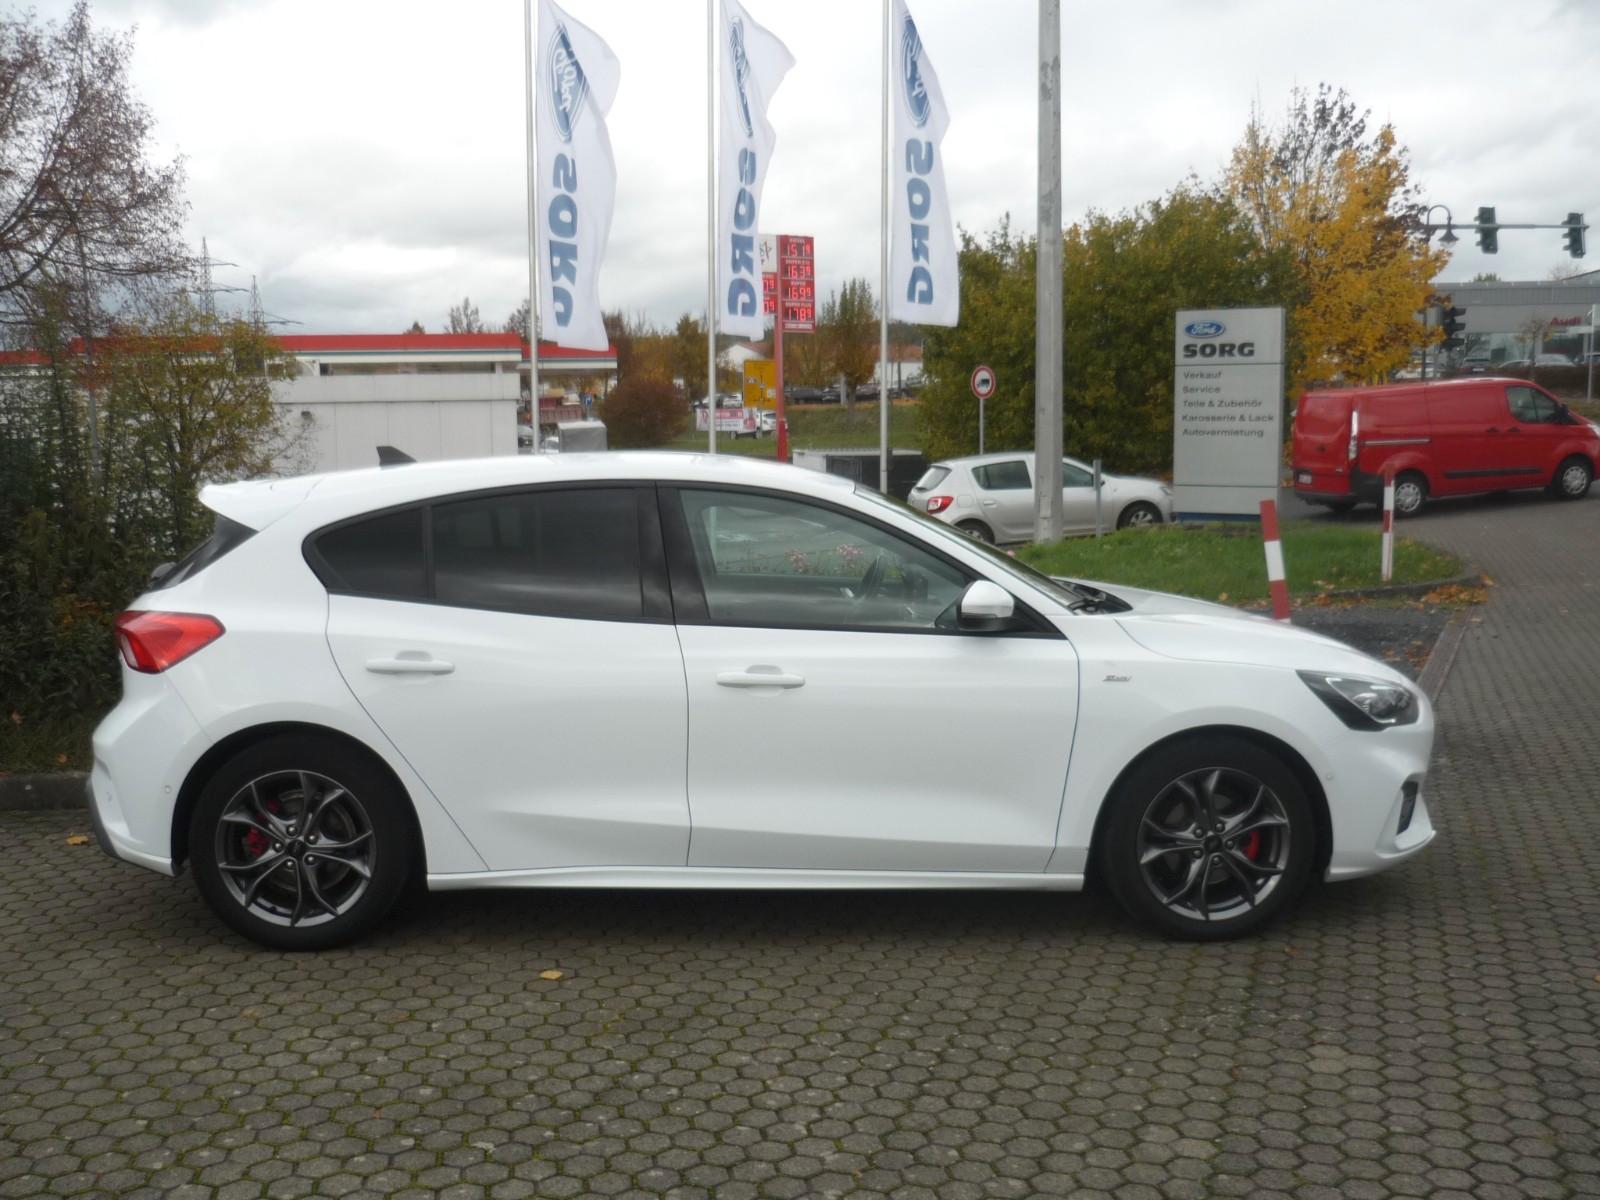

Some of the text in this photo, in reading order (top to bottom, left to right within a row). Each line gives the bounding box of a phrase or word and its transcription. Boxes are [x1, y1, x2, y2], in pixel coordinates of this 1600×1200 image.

[1183, 343, 1255, 358] SORG
[1183, 371, 1222, 380] Verkauf
[1182, 385, 1221, 394] Service
[1183, 399, 1263, 408] Teile & Zubehör
[1181, 414, 1274, 423] Karosserie & Lack
[1182, 428, 1264, 438] Autovermietung
